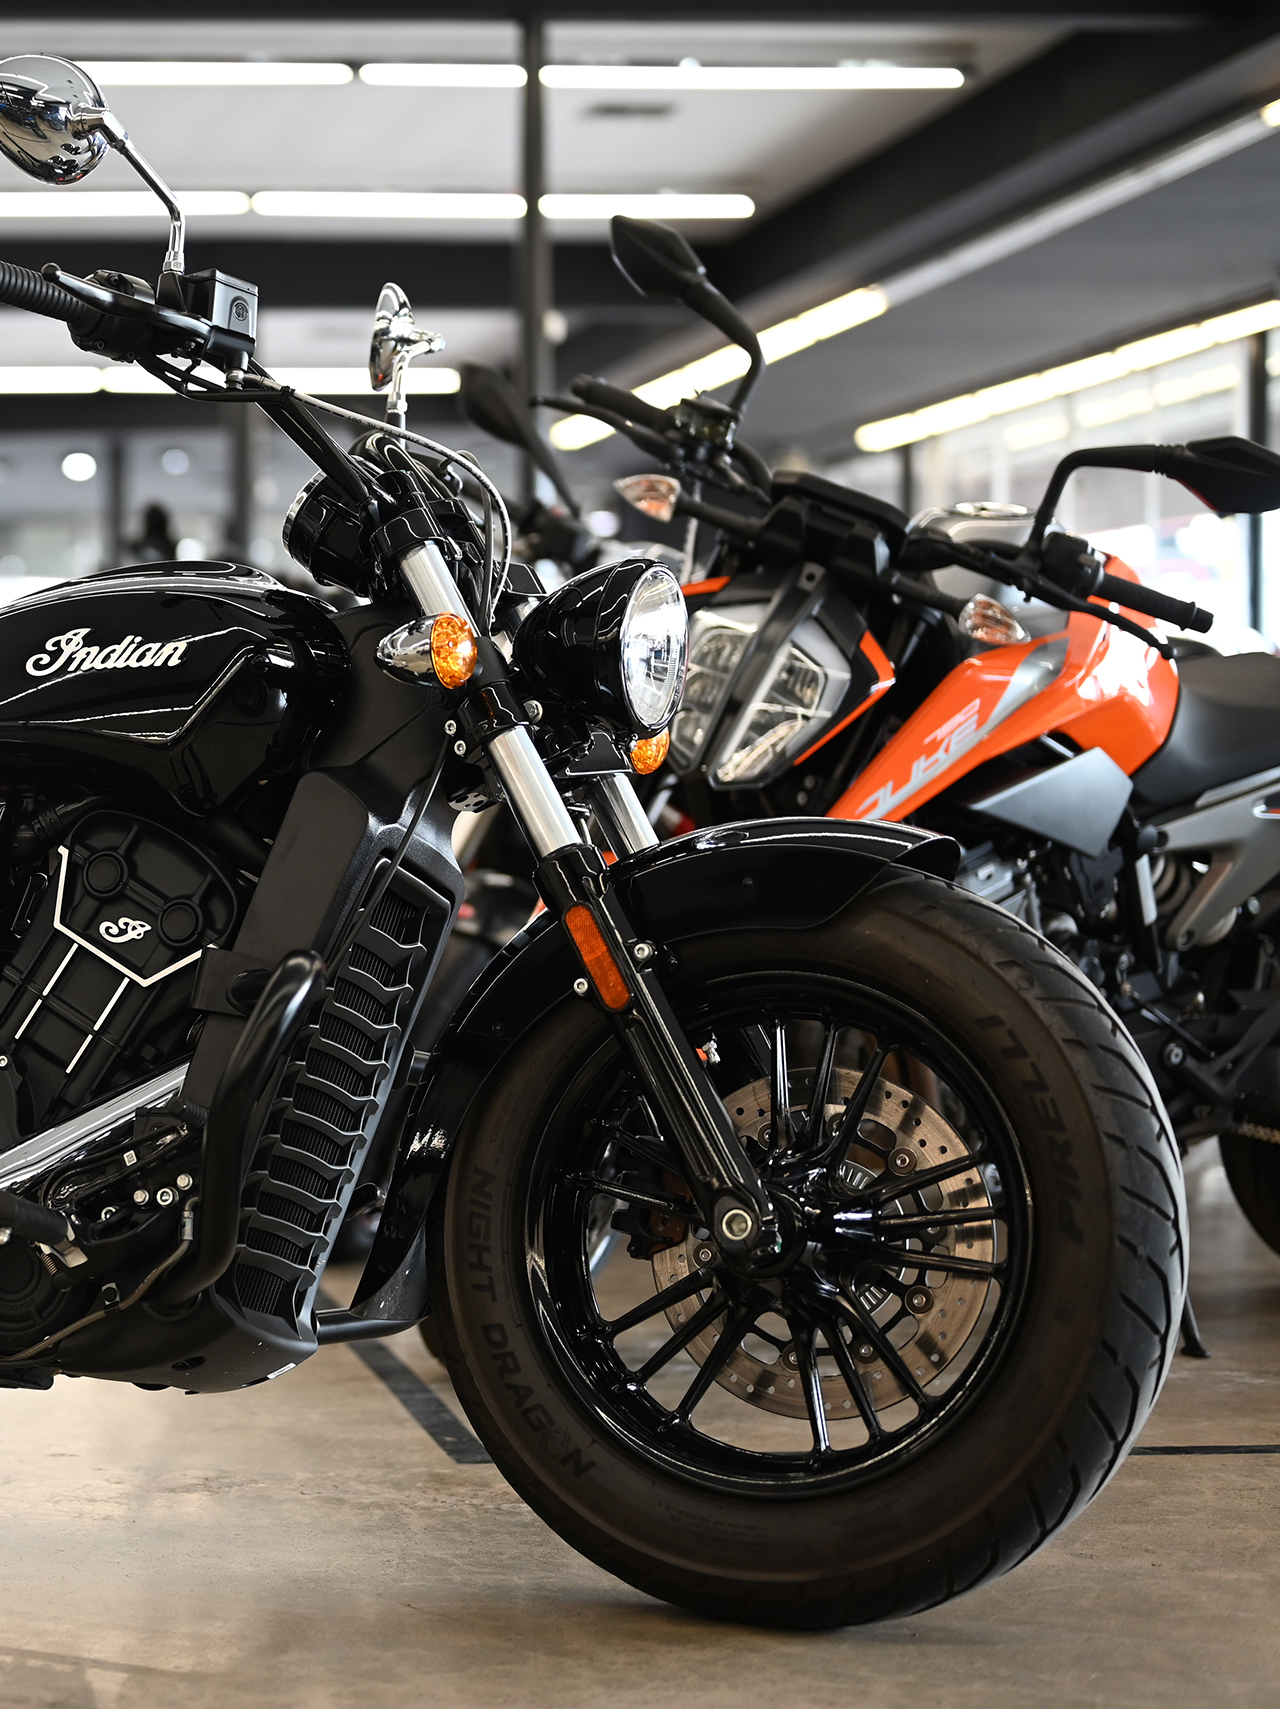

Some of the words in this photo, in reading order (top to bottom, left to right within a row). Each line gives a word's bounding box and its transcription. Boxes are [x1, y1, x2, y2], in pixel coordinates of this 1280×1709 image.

[25, 627, 188, 677] Indian
[973, 1014, 1086, 1246] PIRELLI
[467, 1165, 497, 1303] NIGHT
[481, 1322, 598, 1480] DRAGON
